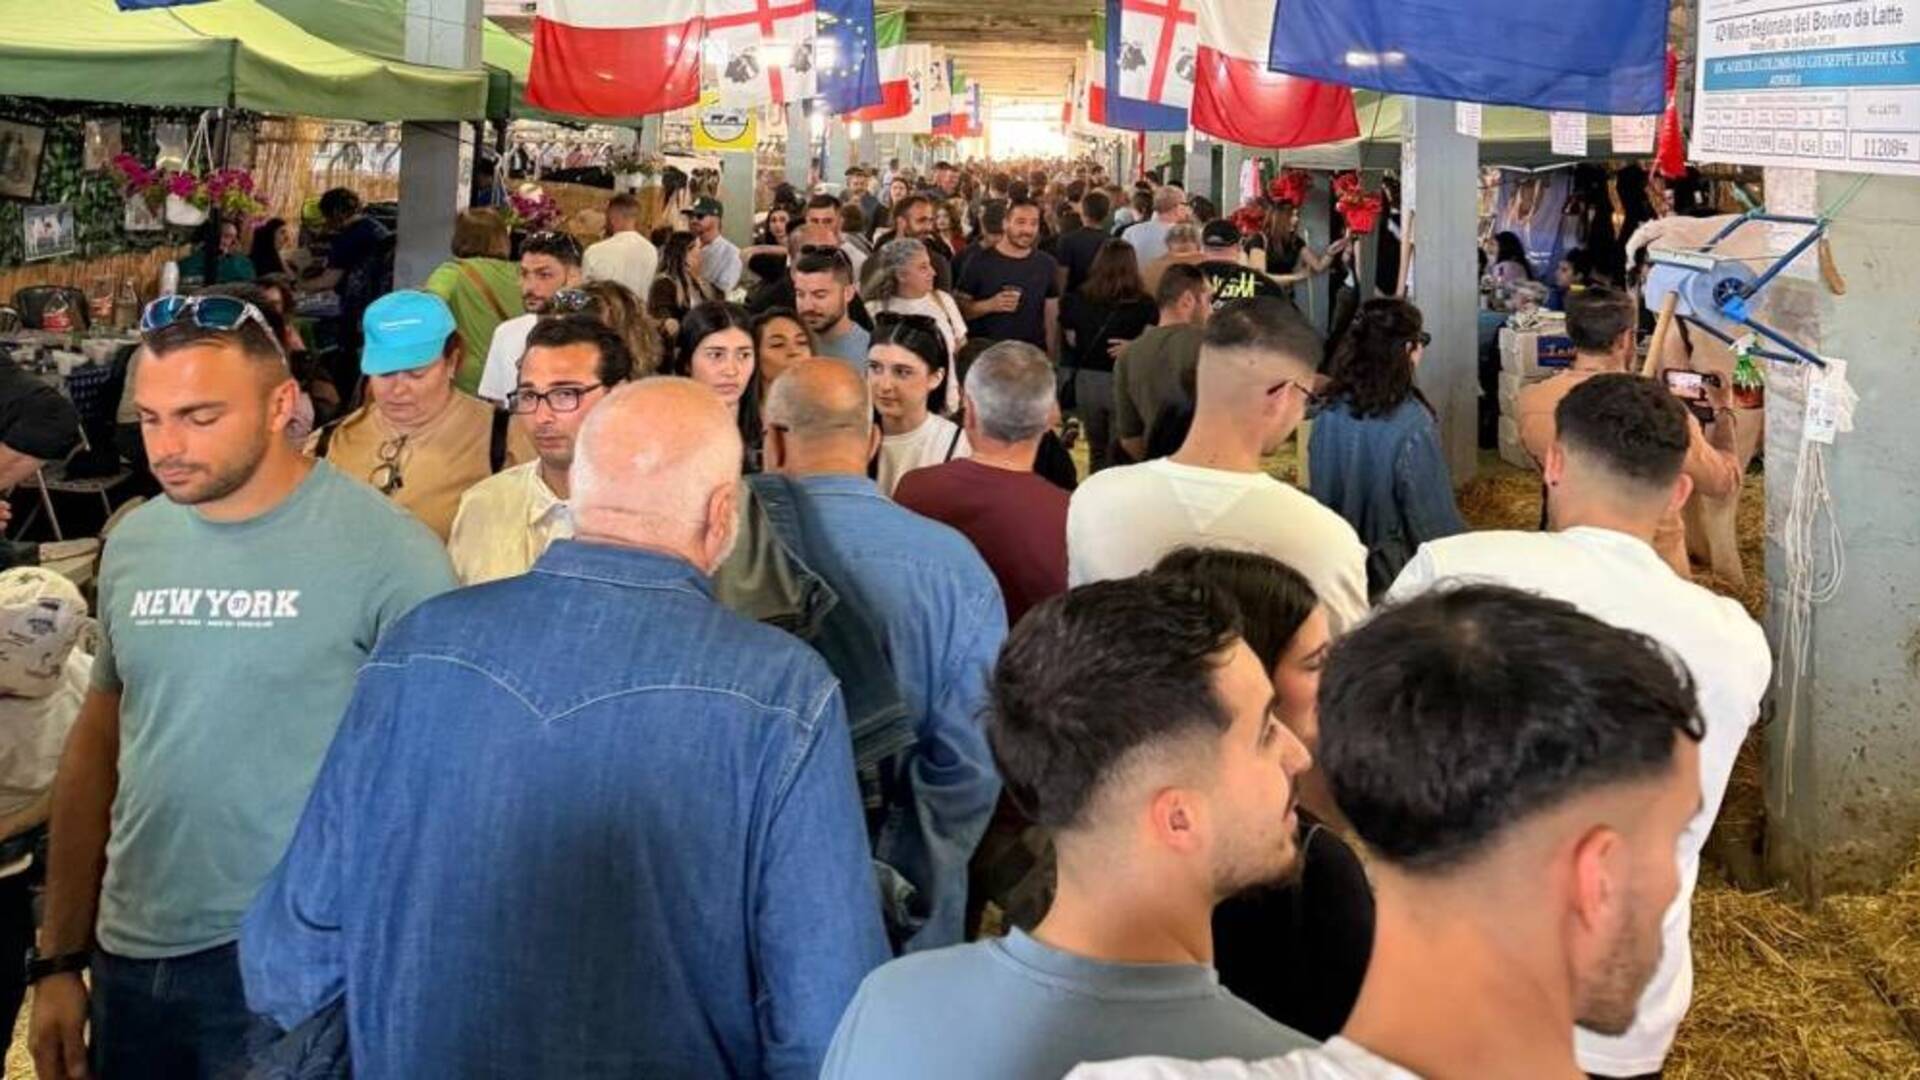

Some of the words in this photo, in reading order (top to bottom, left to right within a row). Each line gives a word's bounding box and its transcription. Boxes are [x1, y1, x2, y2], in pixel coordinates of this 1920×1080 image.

[1751, 15, 1792, 41] Regionale
[1794, 11, 1810, 33] del
[1813, 10, 1852, 31] Bovino
[1854, 7, 1870, 28] da
[1873, 4, 1904, 26] Latte
[130, 587, 202, 618] NEW
[206, 589, 300, 619] YORK
